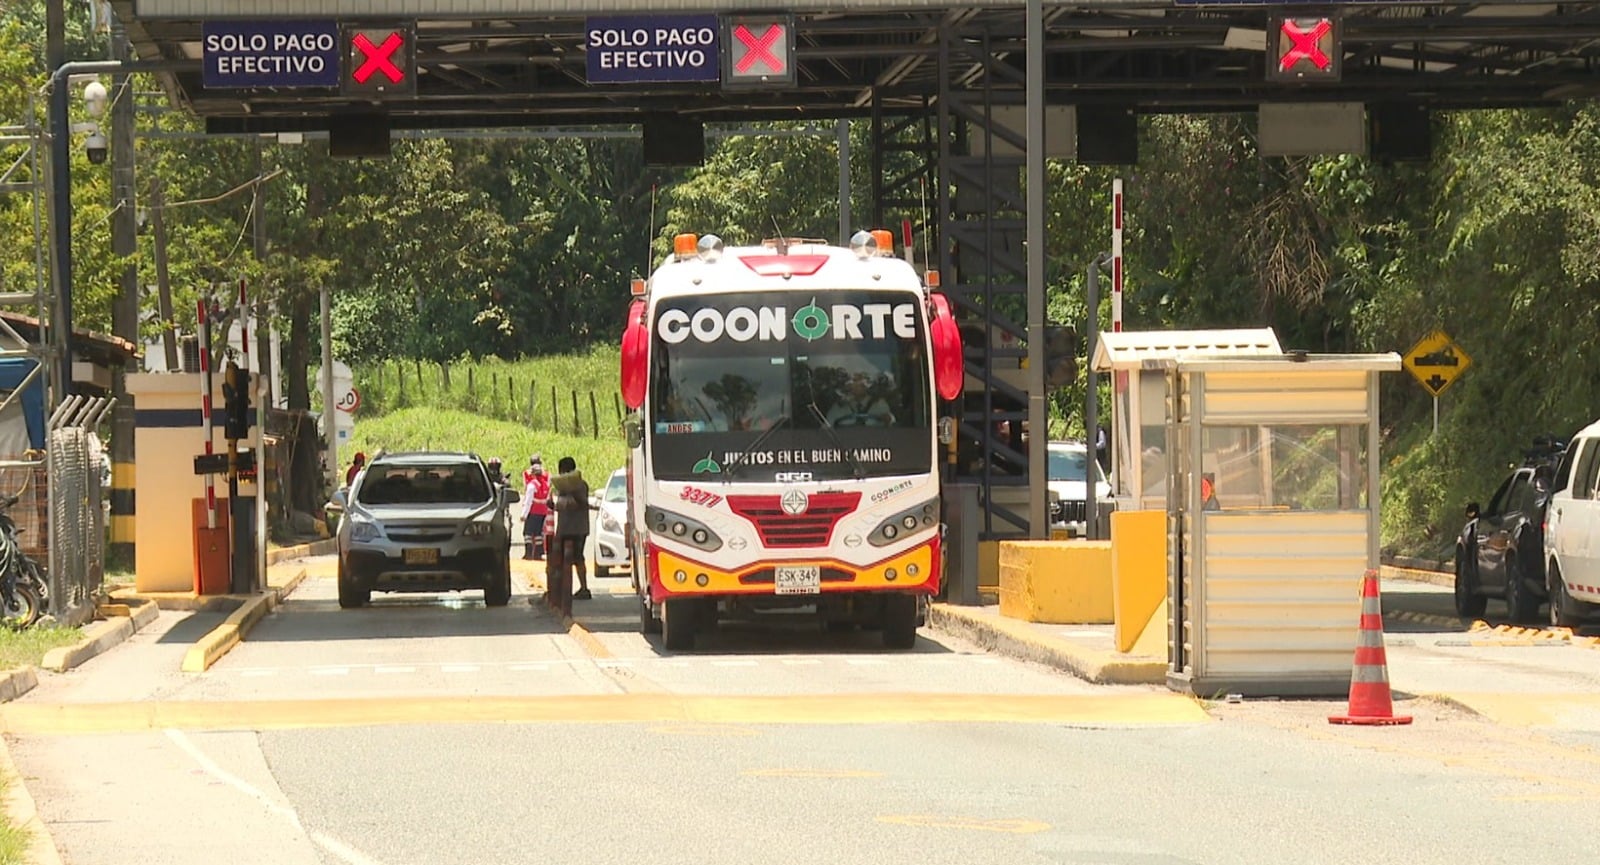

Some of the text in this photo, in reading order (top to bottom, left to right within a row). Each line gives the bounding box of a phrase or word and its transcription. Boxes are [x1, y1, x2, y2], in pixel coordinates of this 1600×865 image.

[206, 34, 335, 52] SOLO PAGO
[589, 28, 714, 47] SOLO PAGO
[217, 56, 325, 74] EFECTIVO
[600, 50, 706, 69] EFECTIVO
[657, 298, 916, 344] COONORTE
[778, 449, 791, 464] EN
[794, 449, 808, 464] EL
[811, 448, 841, 463] BUEN
[680, 485, 723, 508] 3377
